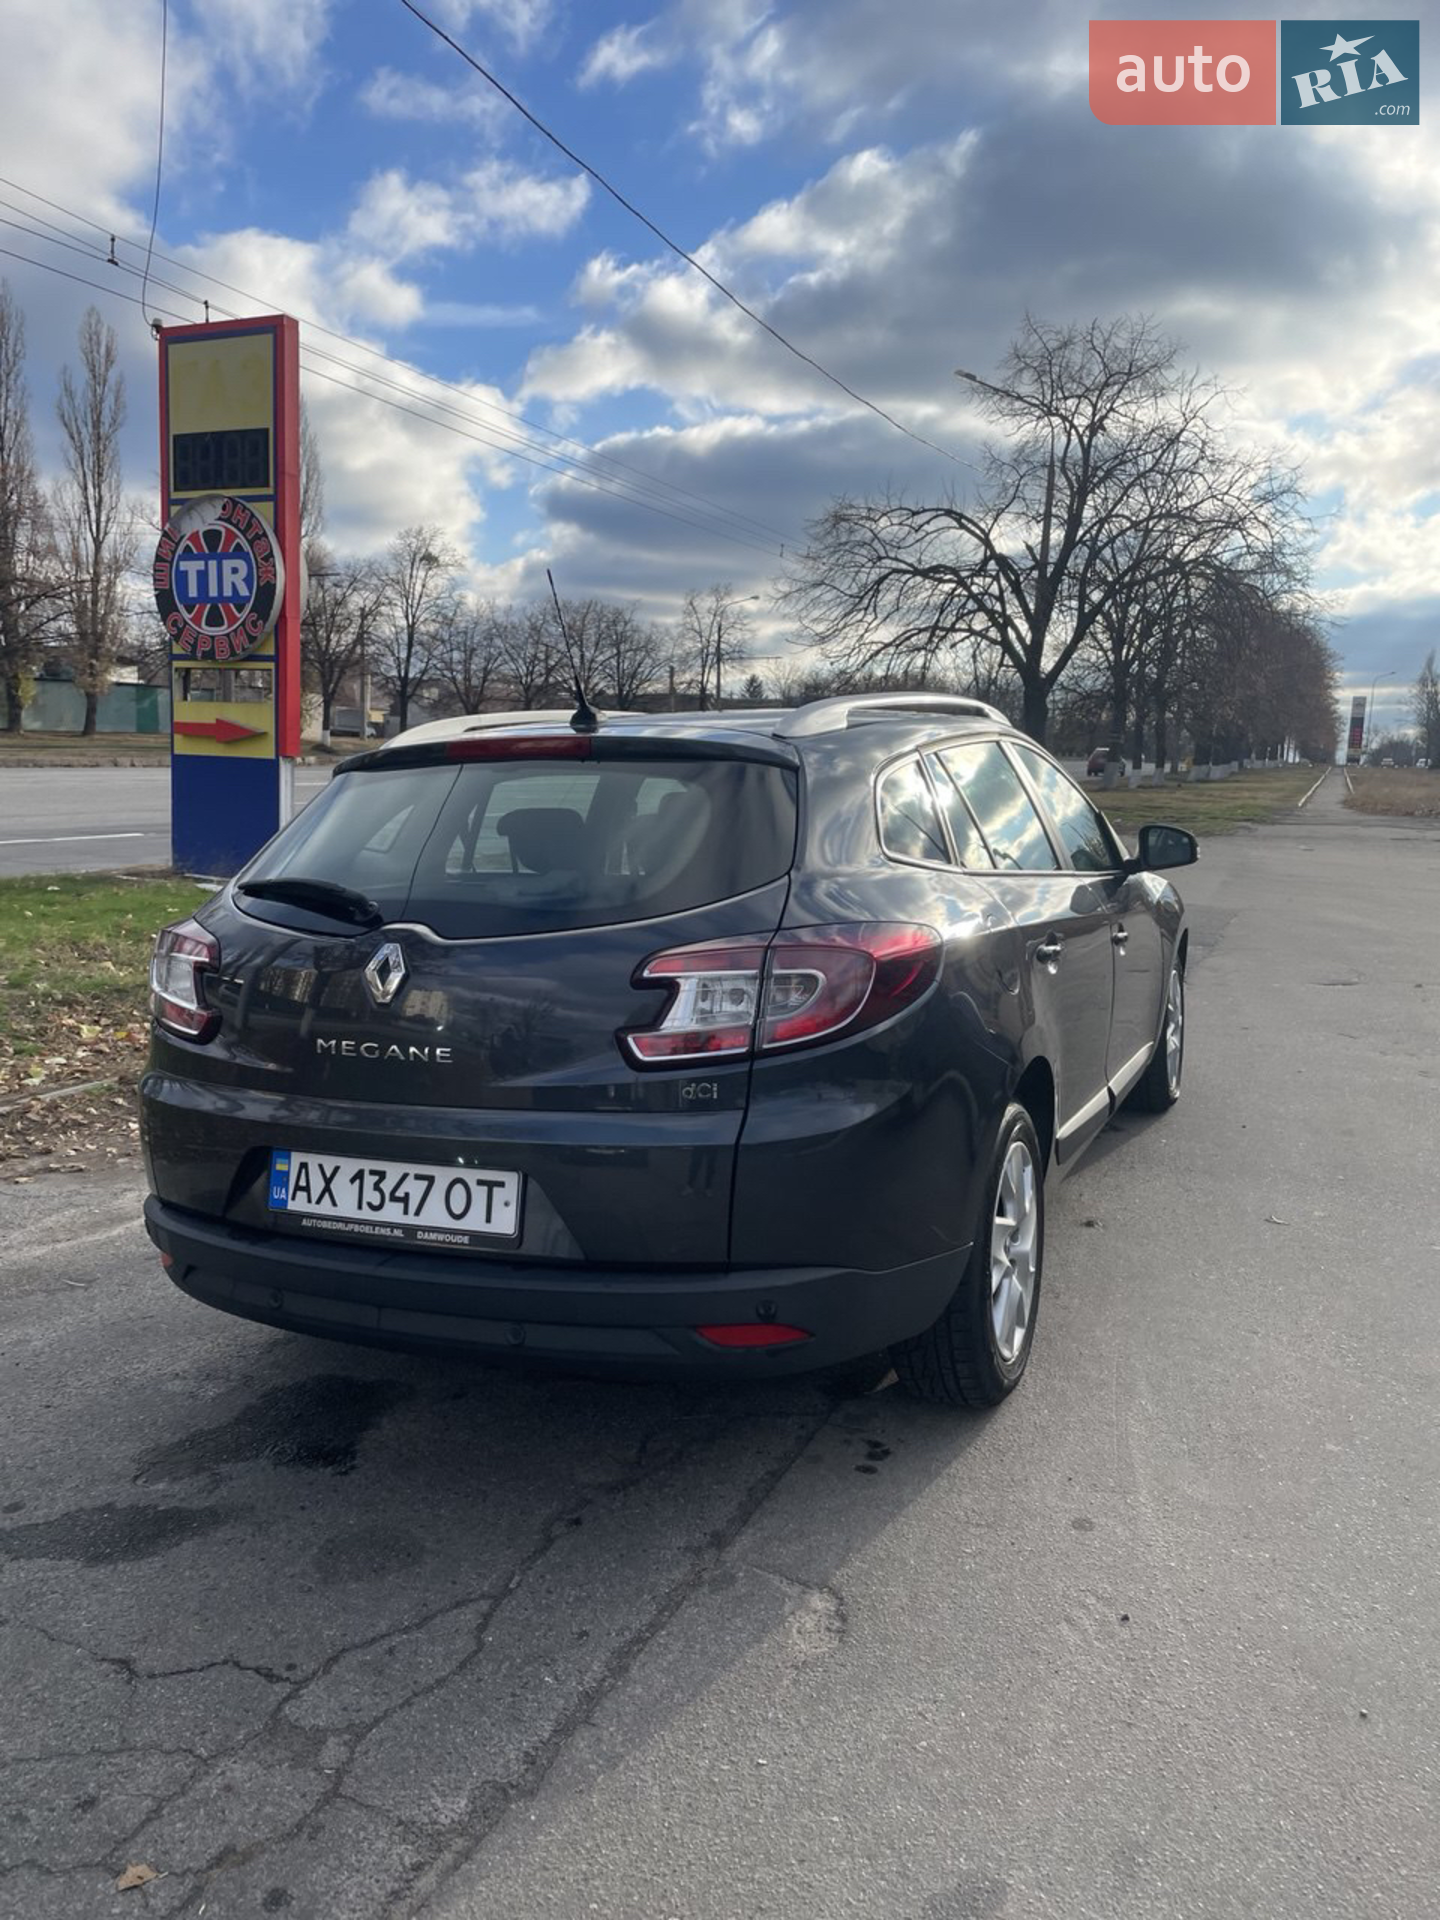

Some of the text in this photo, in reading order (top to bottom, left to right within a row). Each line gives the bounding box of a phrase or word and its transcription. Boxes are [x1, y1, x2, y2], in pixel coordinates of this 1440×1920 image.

[179, 559, 249, 597] TIR
[166, 612, 263, 659] СЕРВИС
[317, 1038, 453, 1062] MEGANE
[682, 1082, 717, 1099] dCi
[273, 1186, 287, 1200] UA
[291, 1162, 505, 1224] AX 1347 OT
[302, 1218, 470, 1245] AUTOBEDRIJFBOELENS.NL DAMWOUDE
